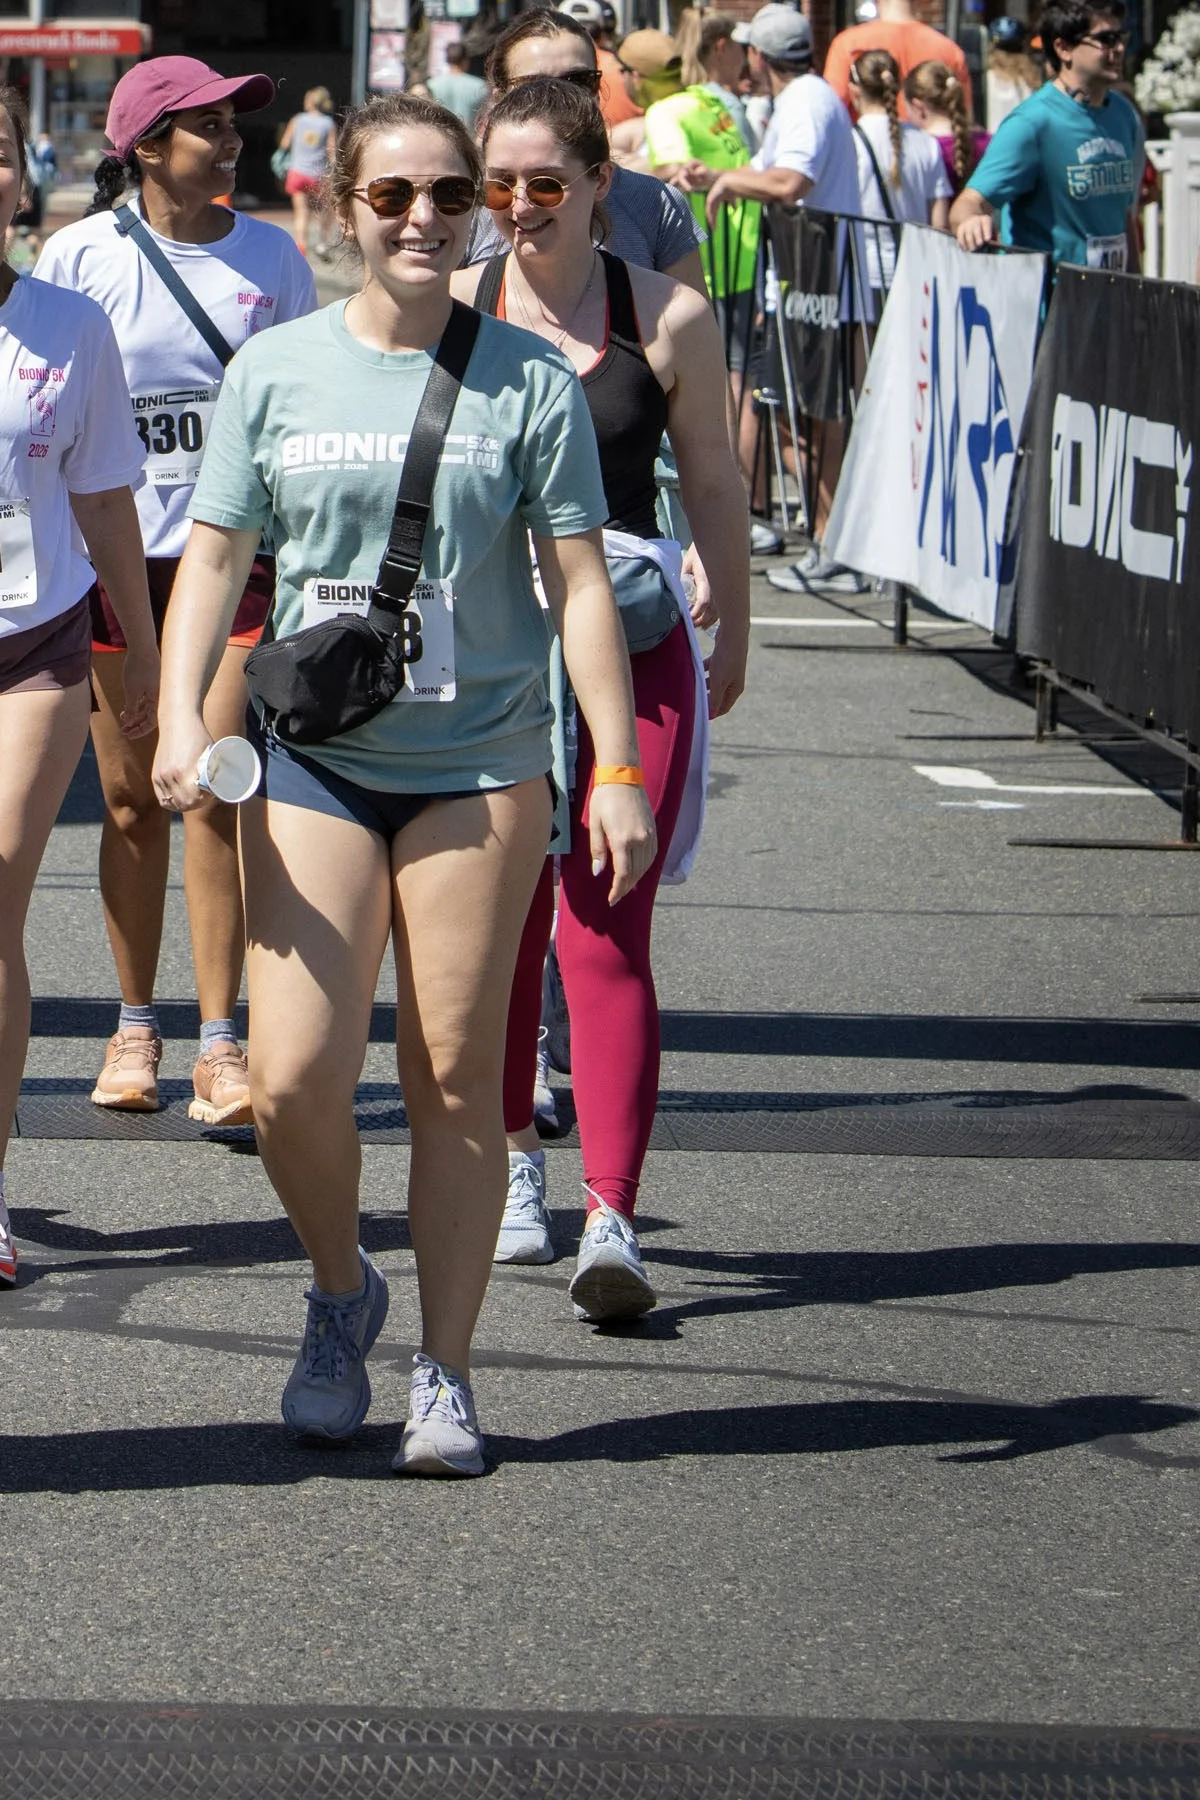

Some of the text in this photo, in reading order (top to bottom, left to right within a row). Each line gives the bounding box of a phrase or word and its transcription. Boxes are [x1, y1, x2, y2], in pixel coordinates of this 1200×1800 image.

[237, 292, 264, 306] BIONIC
[19, 368, 65, 382] BIONIC 5K
[28, 443, 49, 457] 2026
[155, 472, 180, 480] DRINK
[1, 591, 29, 602] DRINK
[318, 585, 372, 600] BIONI
[416, 592, 435, 600] 1Mi
[414, 686, 446, 696] DRINK
